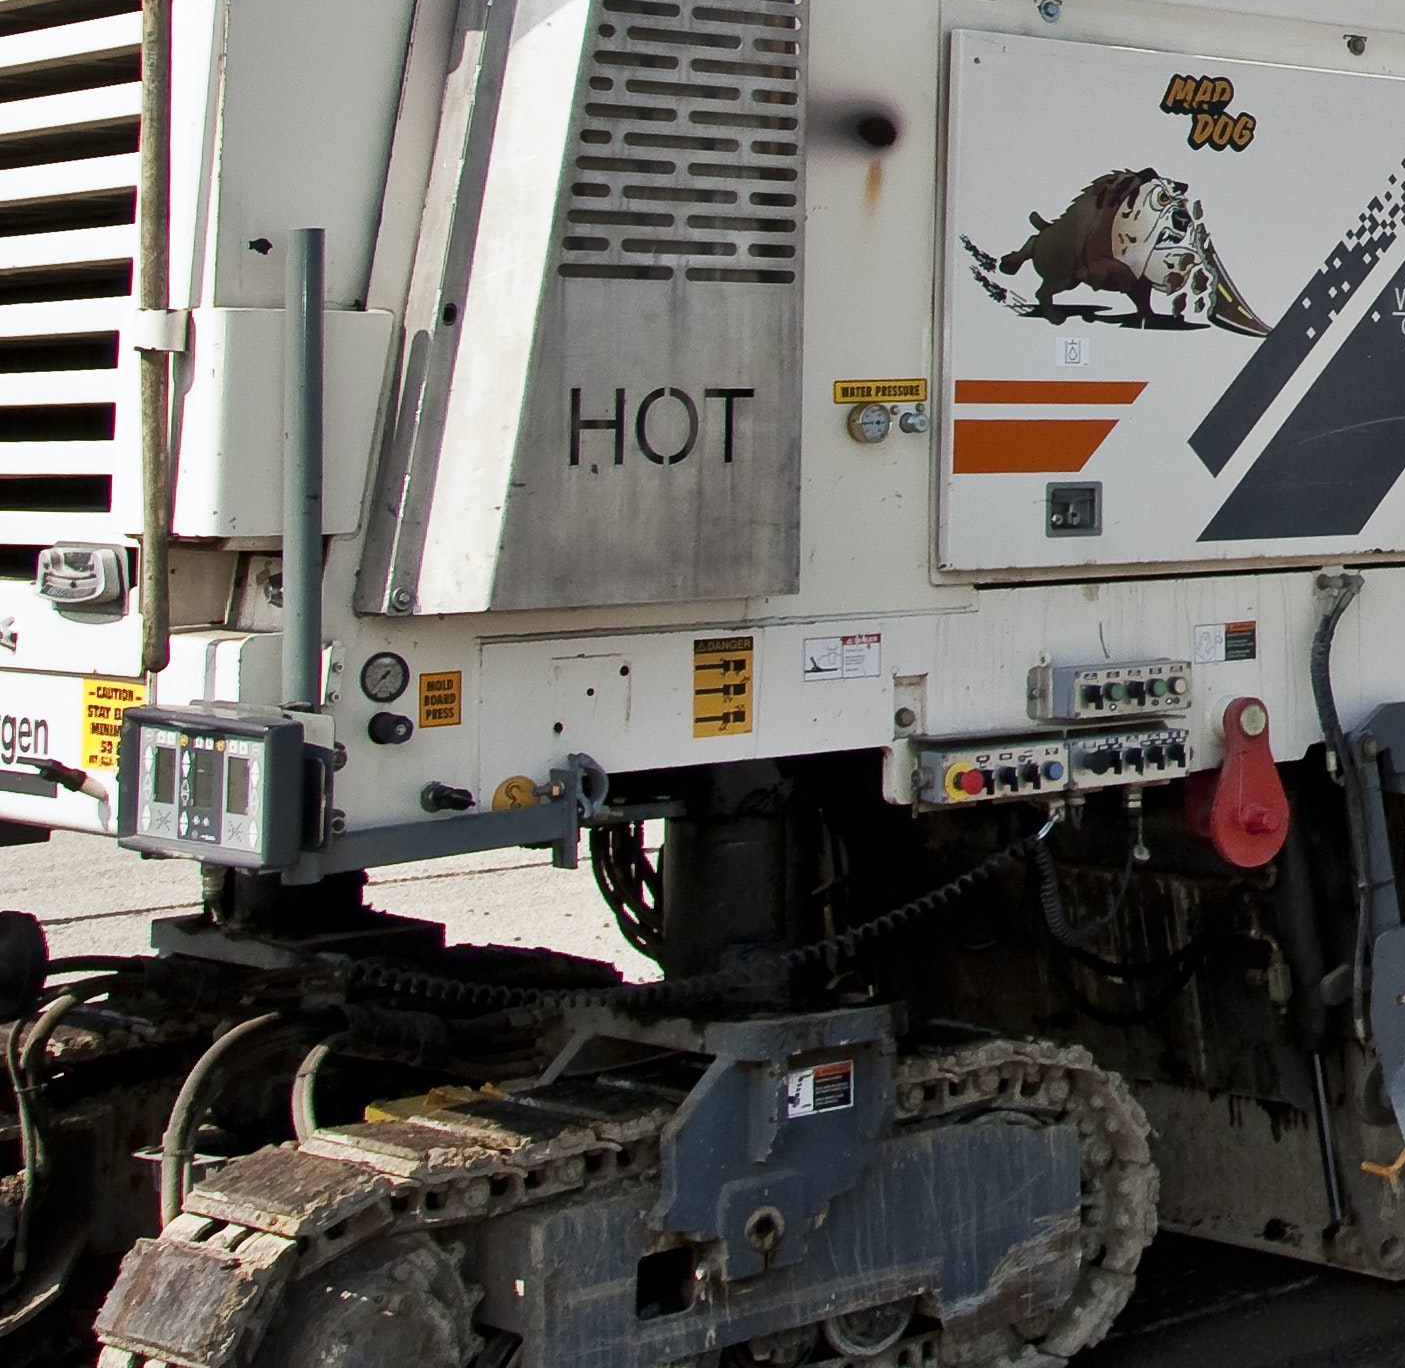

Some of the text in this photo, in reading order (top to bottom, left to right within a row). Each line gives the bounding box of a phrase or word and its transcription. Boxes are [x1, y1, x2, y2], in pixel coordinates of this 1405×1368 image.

[1162, 75, 1234, 112] MAD
[1190, 112, 1256, 149] DOG
[841, 384, 920, 398] WATER PRESSURE
[570, 387, 755, 465] HOT
[707, 640, 752, 651] DANGER
[426, 679, 454, 692] MOLD
[424, 693, 456, 706] BOARD
[426, 707, 455, 720] PRESS
[0, 715, 49, 765] gen
